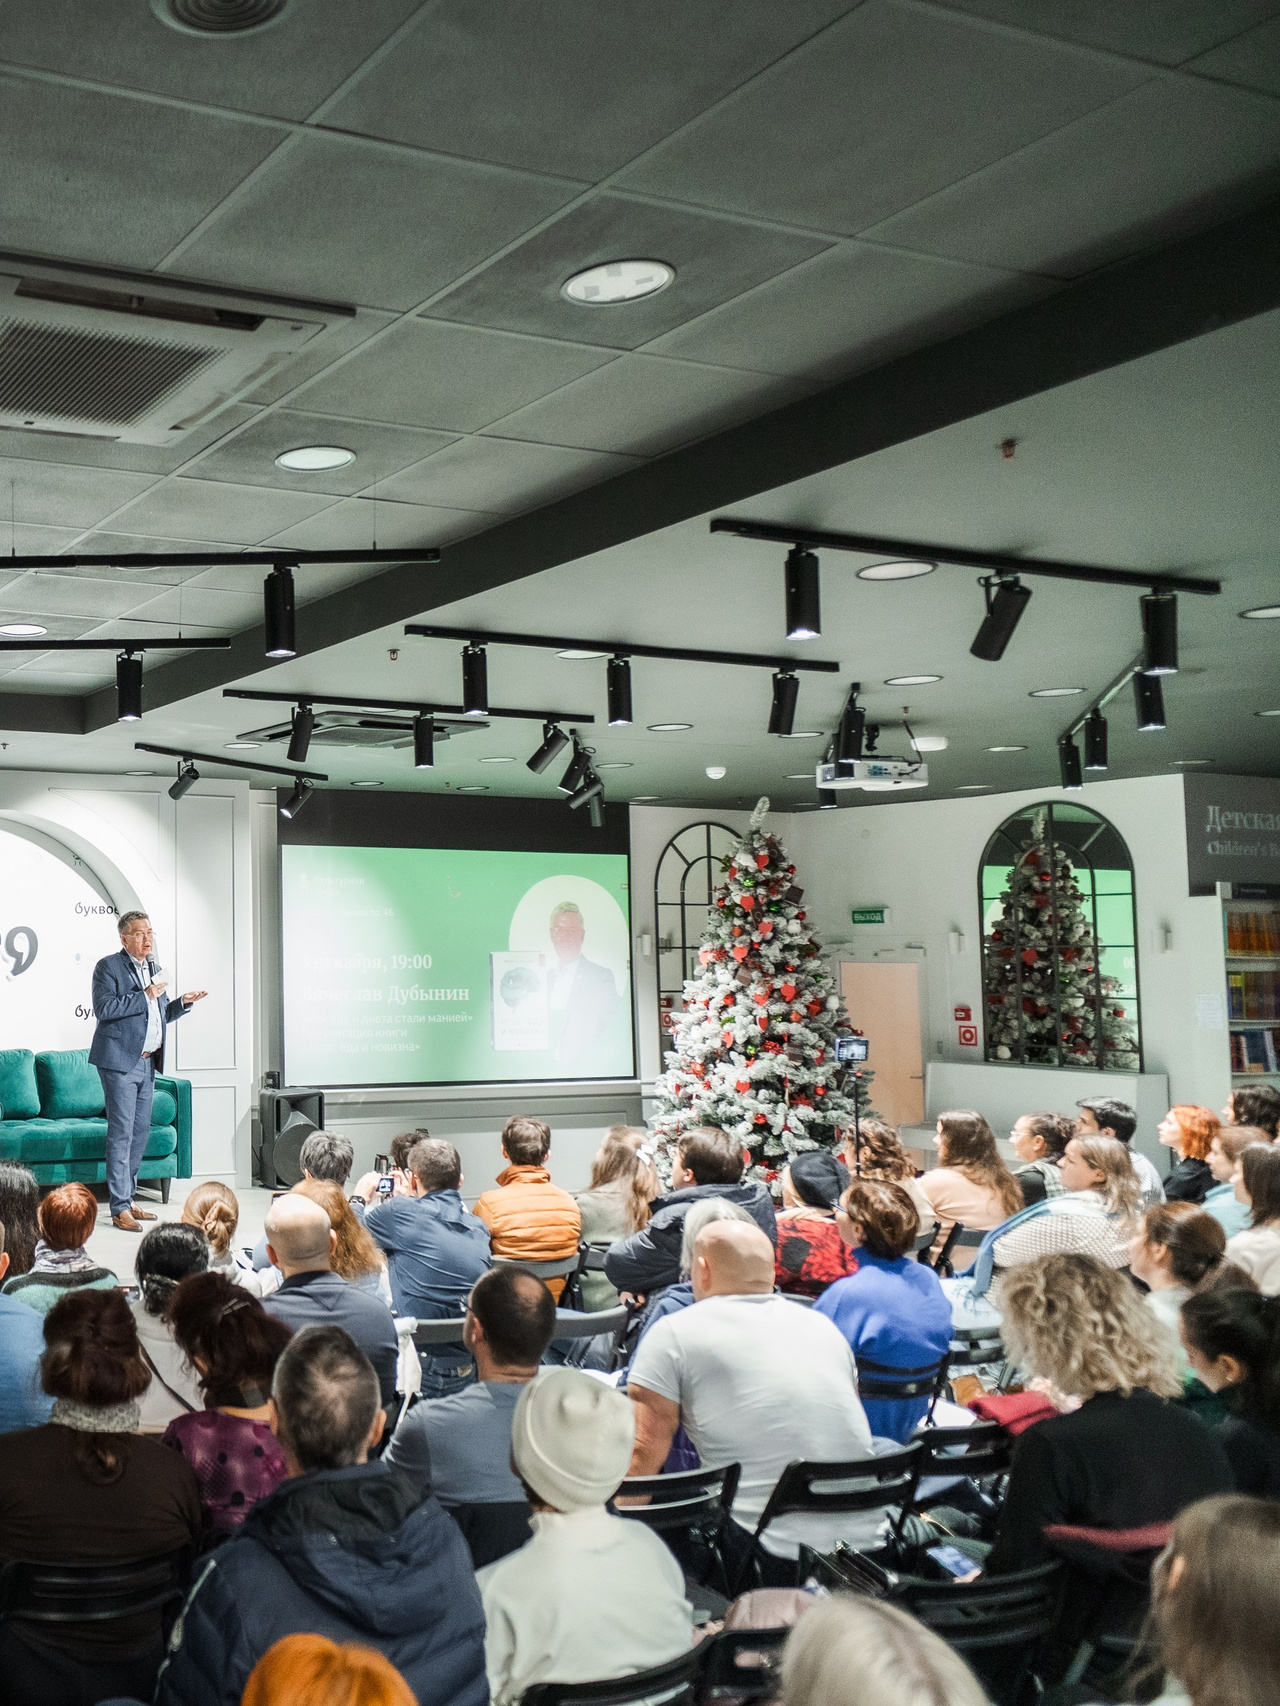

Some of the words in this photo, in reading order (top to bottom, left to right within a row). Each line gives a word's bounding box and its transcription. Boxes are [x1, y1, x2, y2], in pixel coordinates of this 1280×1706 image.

[384, 907, 394, 917] 46
[854, 912, 883, 922] ВЫХОД
[313, 953, 387, 973] декабря,
[391, 954, 433, 969] 19:00
[387, 984, 470, 1005] Дубынин
[360, 1014, 393, 1025] диета
[395, 1013, 426, 1023] стали
[427, 1011, 473, 1023] манией»
[375, 1029, 408, 1038] книги
[362, 1043, 368, 1051] и
[371, 1042, 421, 1052] новизна»
